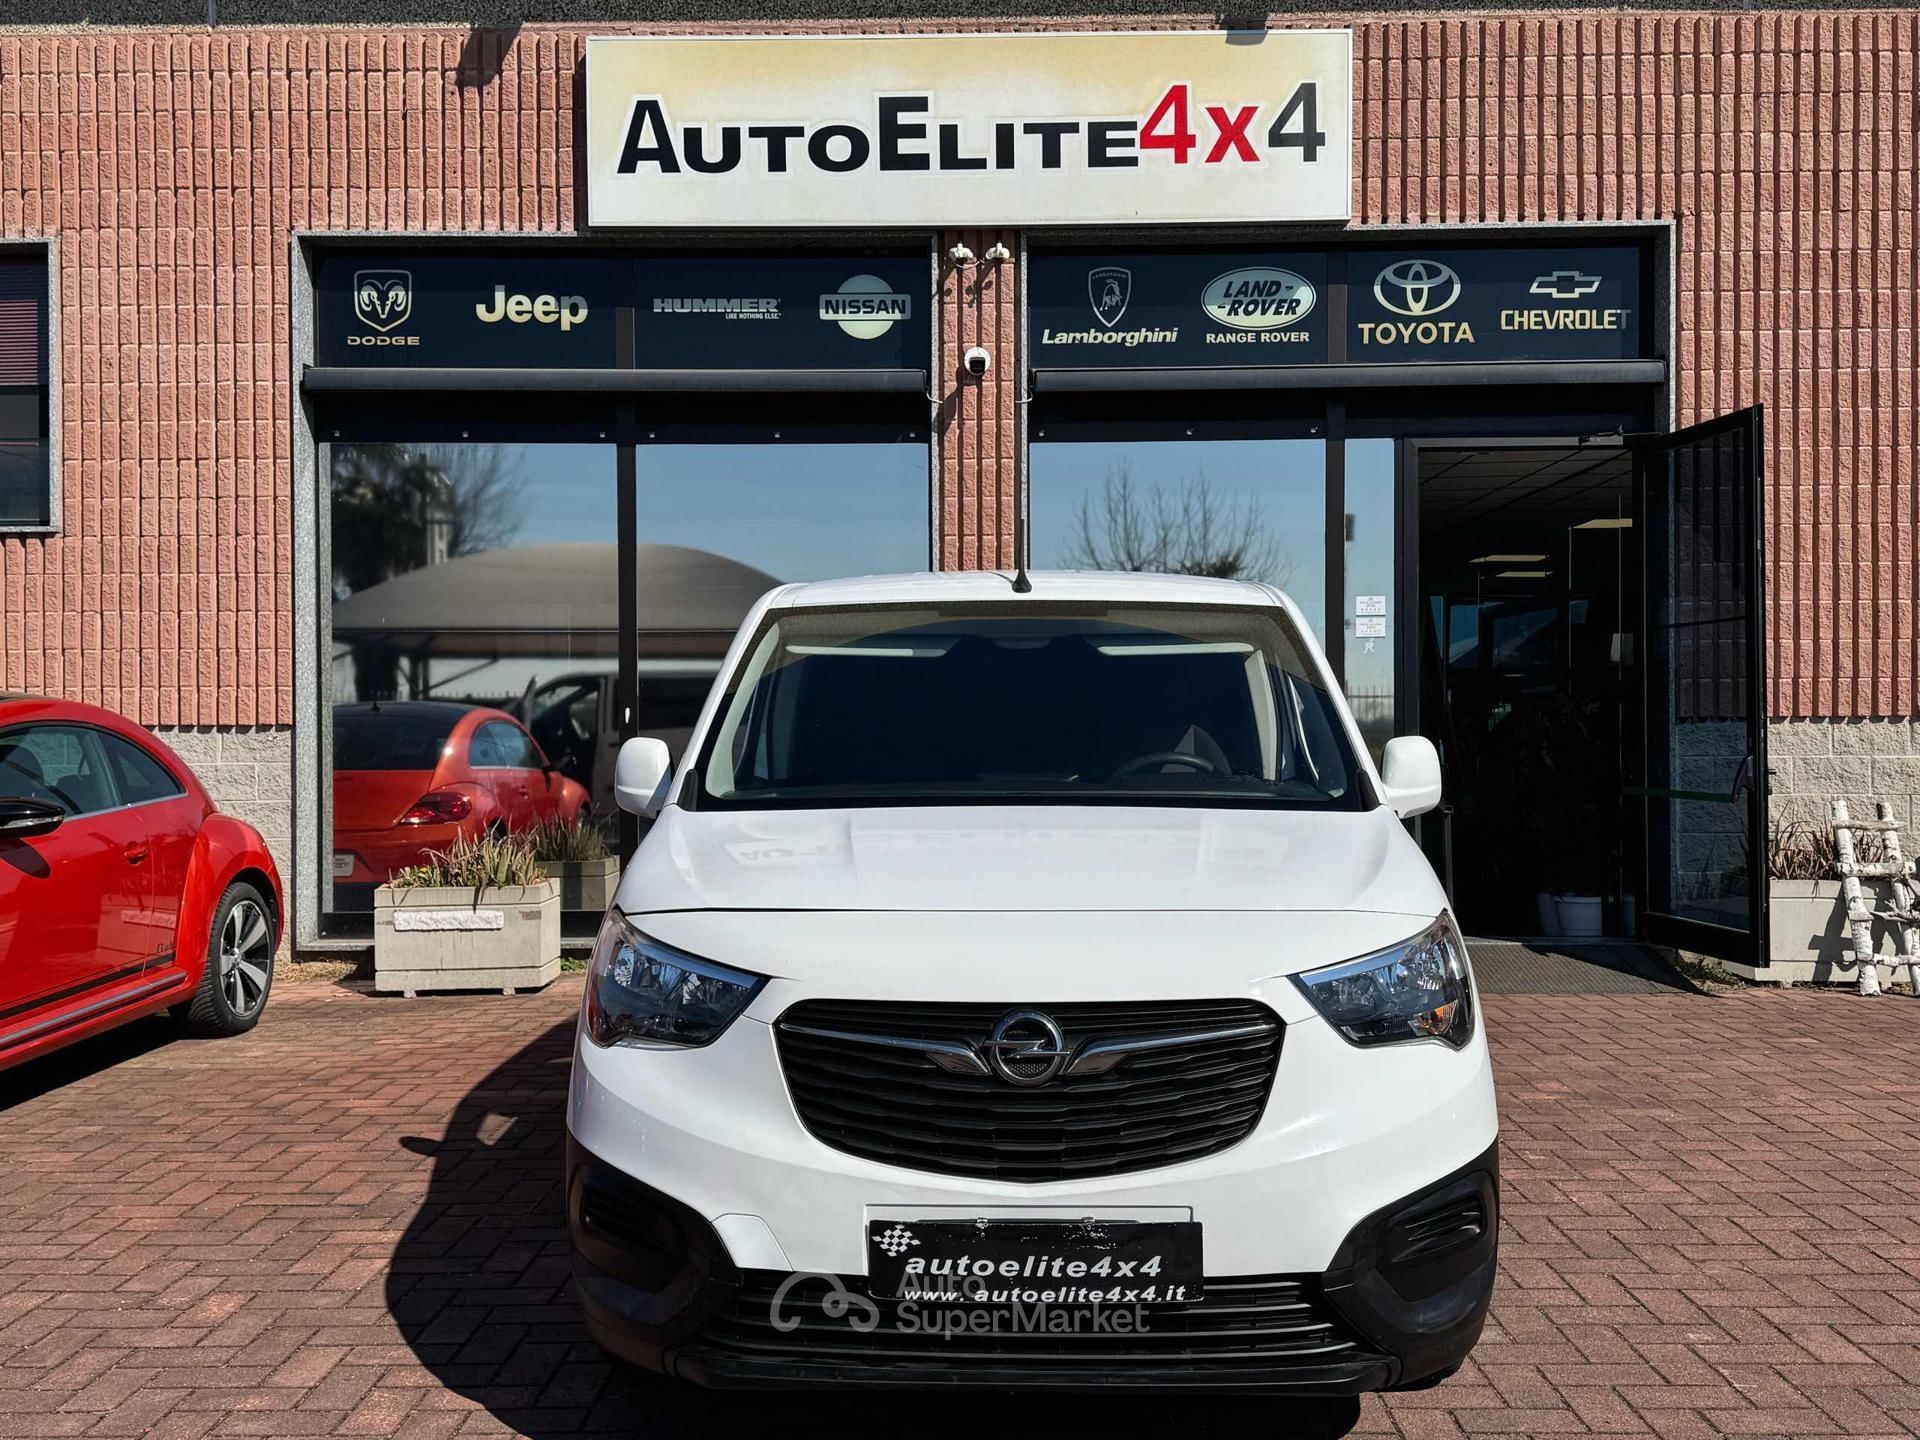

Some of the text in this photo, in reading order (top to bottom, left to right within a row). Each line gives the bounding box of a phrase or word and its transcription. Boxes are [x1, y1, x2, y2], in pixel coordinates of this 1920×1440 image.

[476, 284, 589, 331] Jeep
[653, 298, 780, 313] HUMMER
[824, 299, 907, 315] NISSAN
[1500, 309, 1632, 330] CHEVROLET
[347, 336, 420, 346] DODGE
[1042, 327, 1178, 347] Lamborghini
[1206, 331, 1310, 344] RANGE ROVER
[1358, 322, 1475, 345] TOYOTA
[905, 1255, 1162, 1278] autoelite4x4
